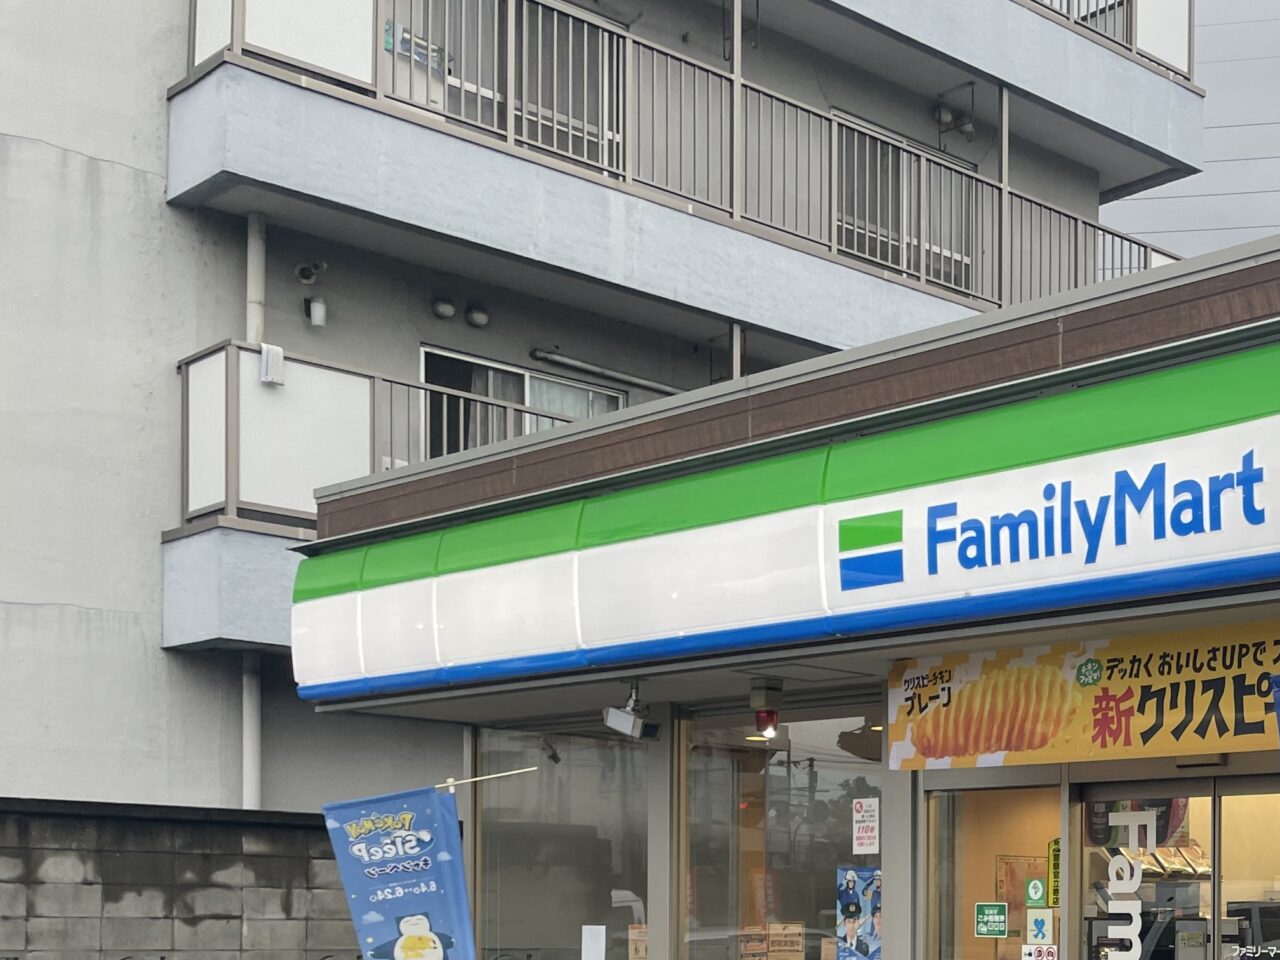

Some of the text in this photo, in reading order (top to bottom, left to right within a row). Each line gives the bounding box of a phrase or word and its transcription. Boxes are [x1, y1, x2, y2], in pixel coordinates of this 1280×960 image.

[926, 449, 1265, 575] FamilyMart
[904, 670, 951, 692] クリスピーチキン
[904, 687, 951, 717] プレーン
[1092, 672, 1277, 749] 新クリスピ
